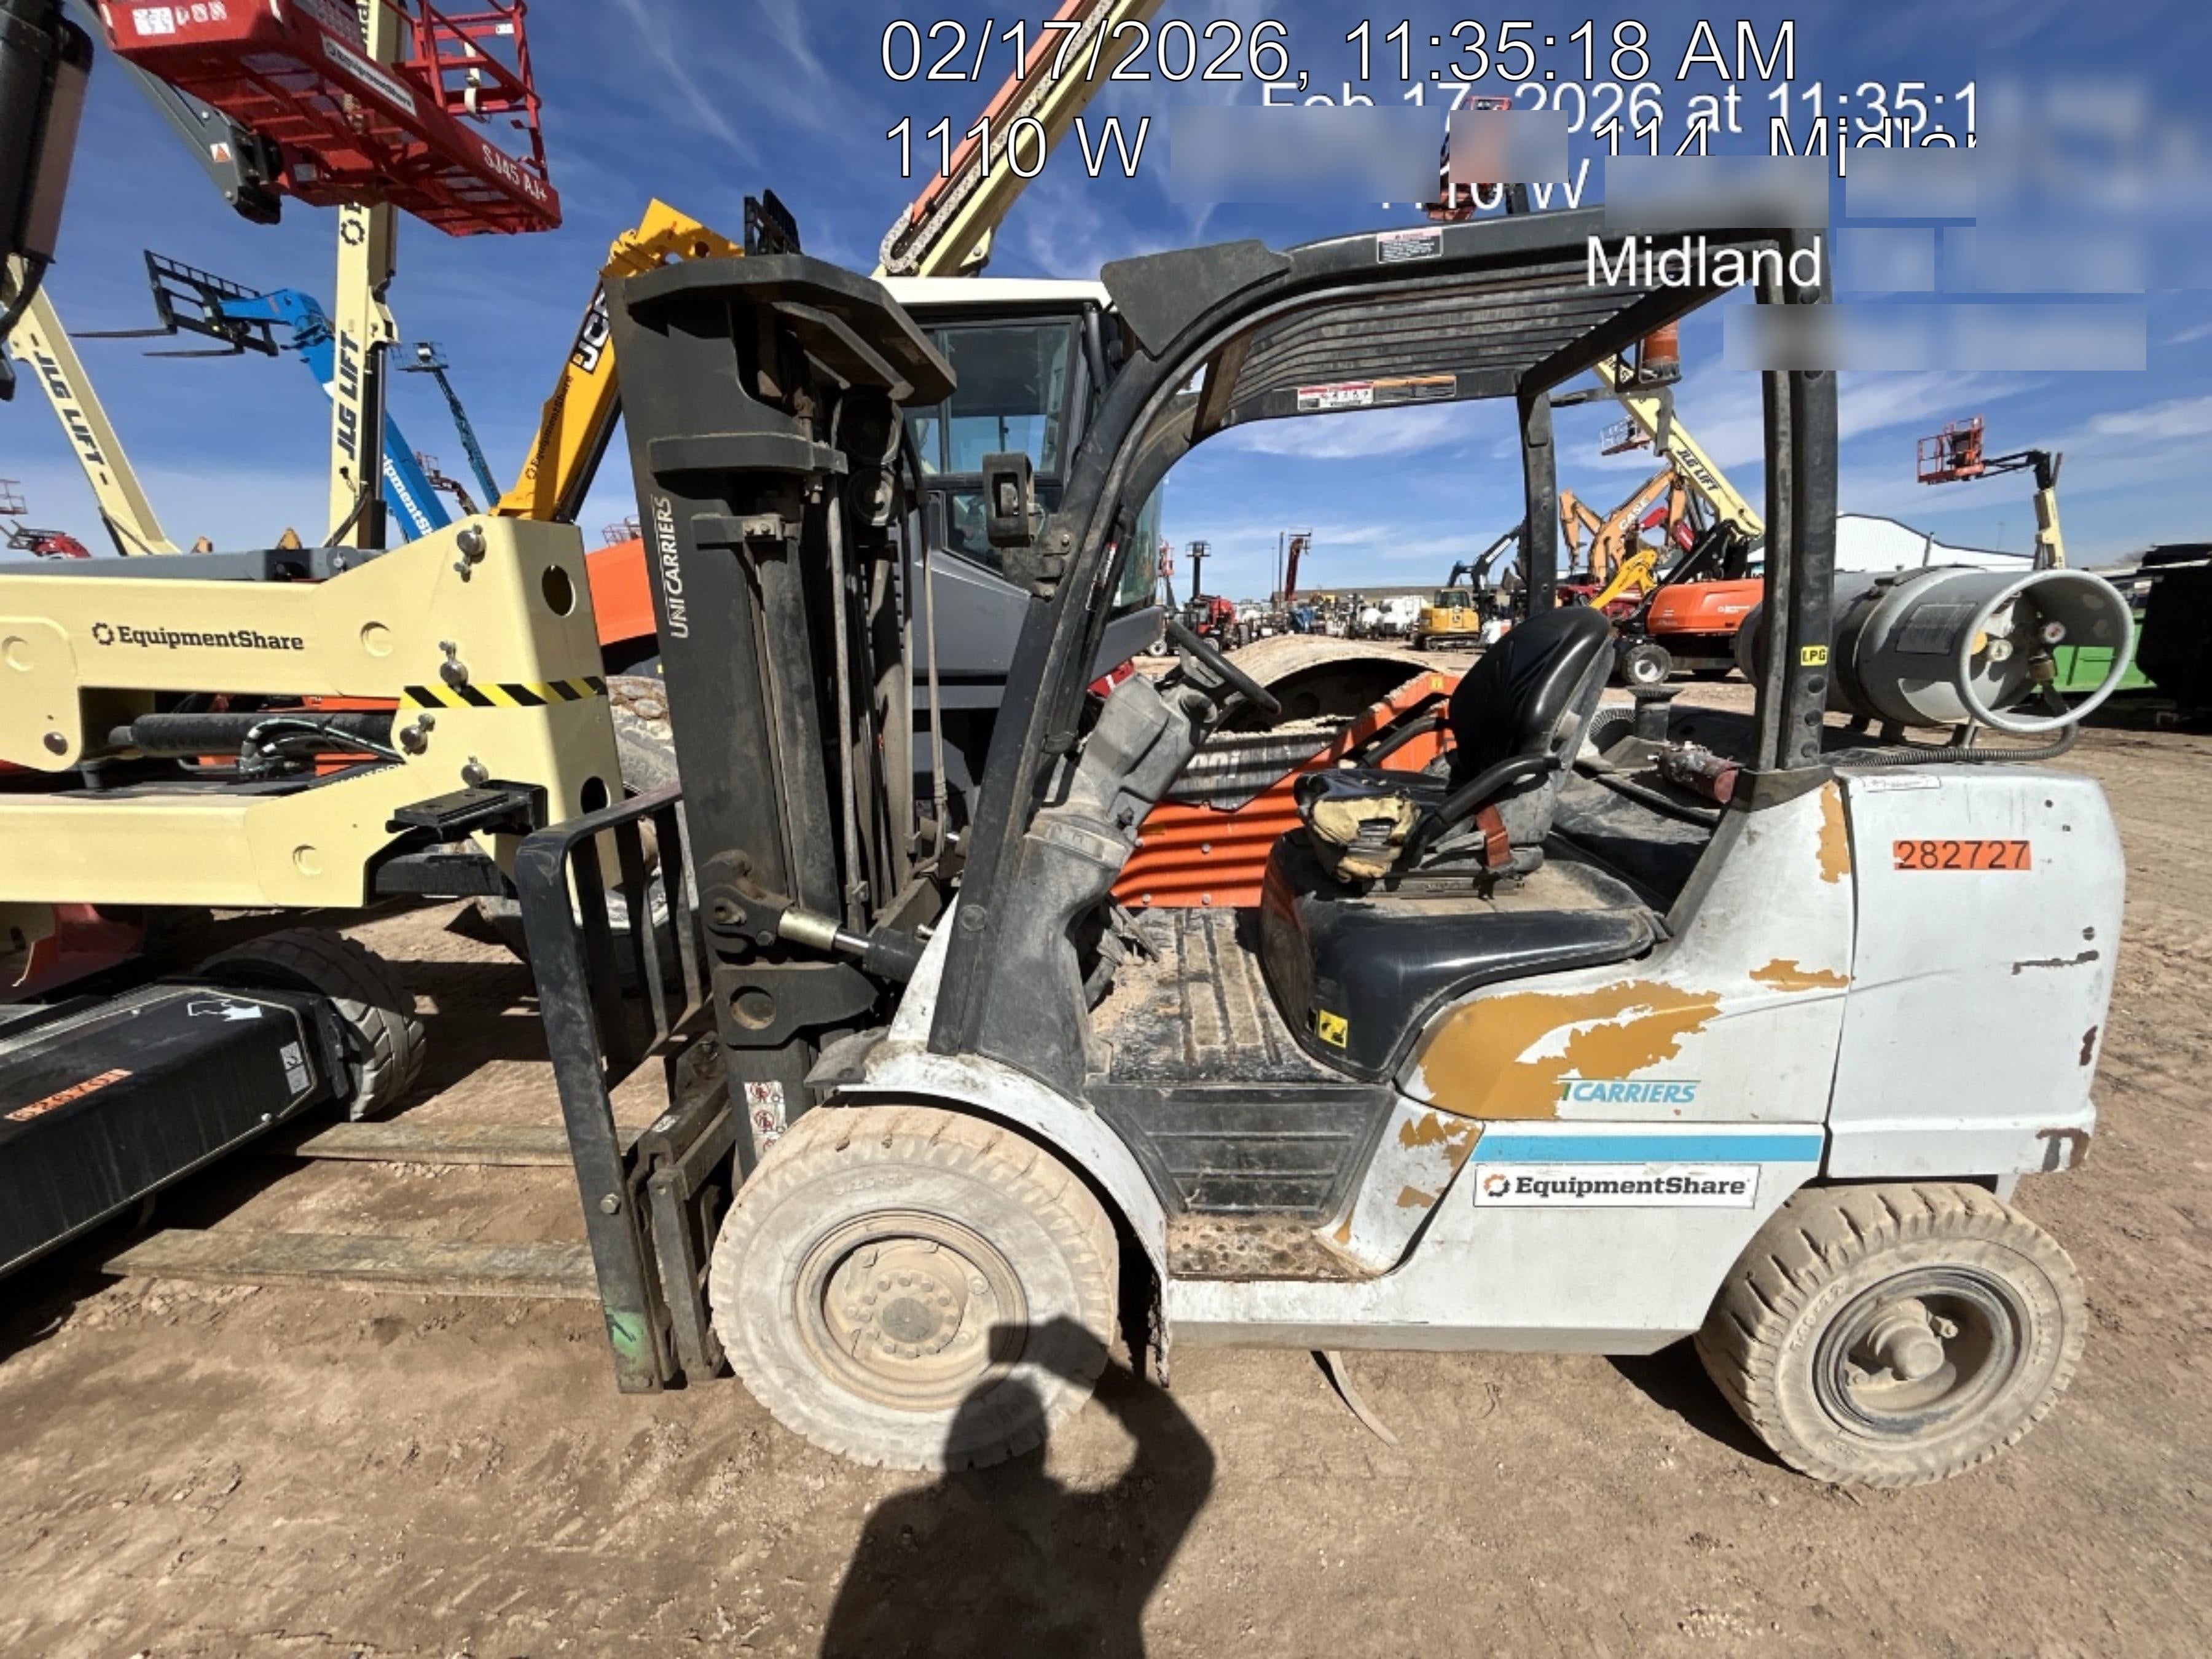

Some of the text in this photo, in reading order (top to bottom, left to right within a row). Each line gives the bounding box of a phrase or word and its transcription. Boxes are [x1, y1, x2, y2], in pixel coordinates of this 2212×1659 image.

[482, 144, 520, 185] SJ45
[33, 350, 104, 465] JLG LIFT
[337, 329, 358, 461] JLG LIFT
[1676, 449, 1719, 492] JLG LIFT
[117, 626, 304, 650] EquipmentShare
[1802, 649, 1826, 662] LPG
[1897, 840, 2030, 869] 282727
[1515, 1176, 1746, 1198] EquipmentShare
